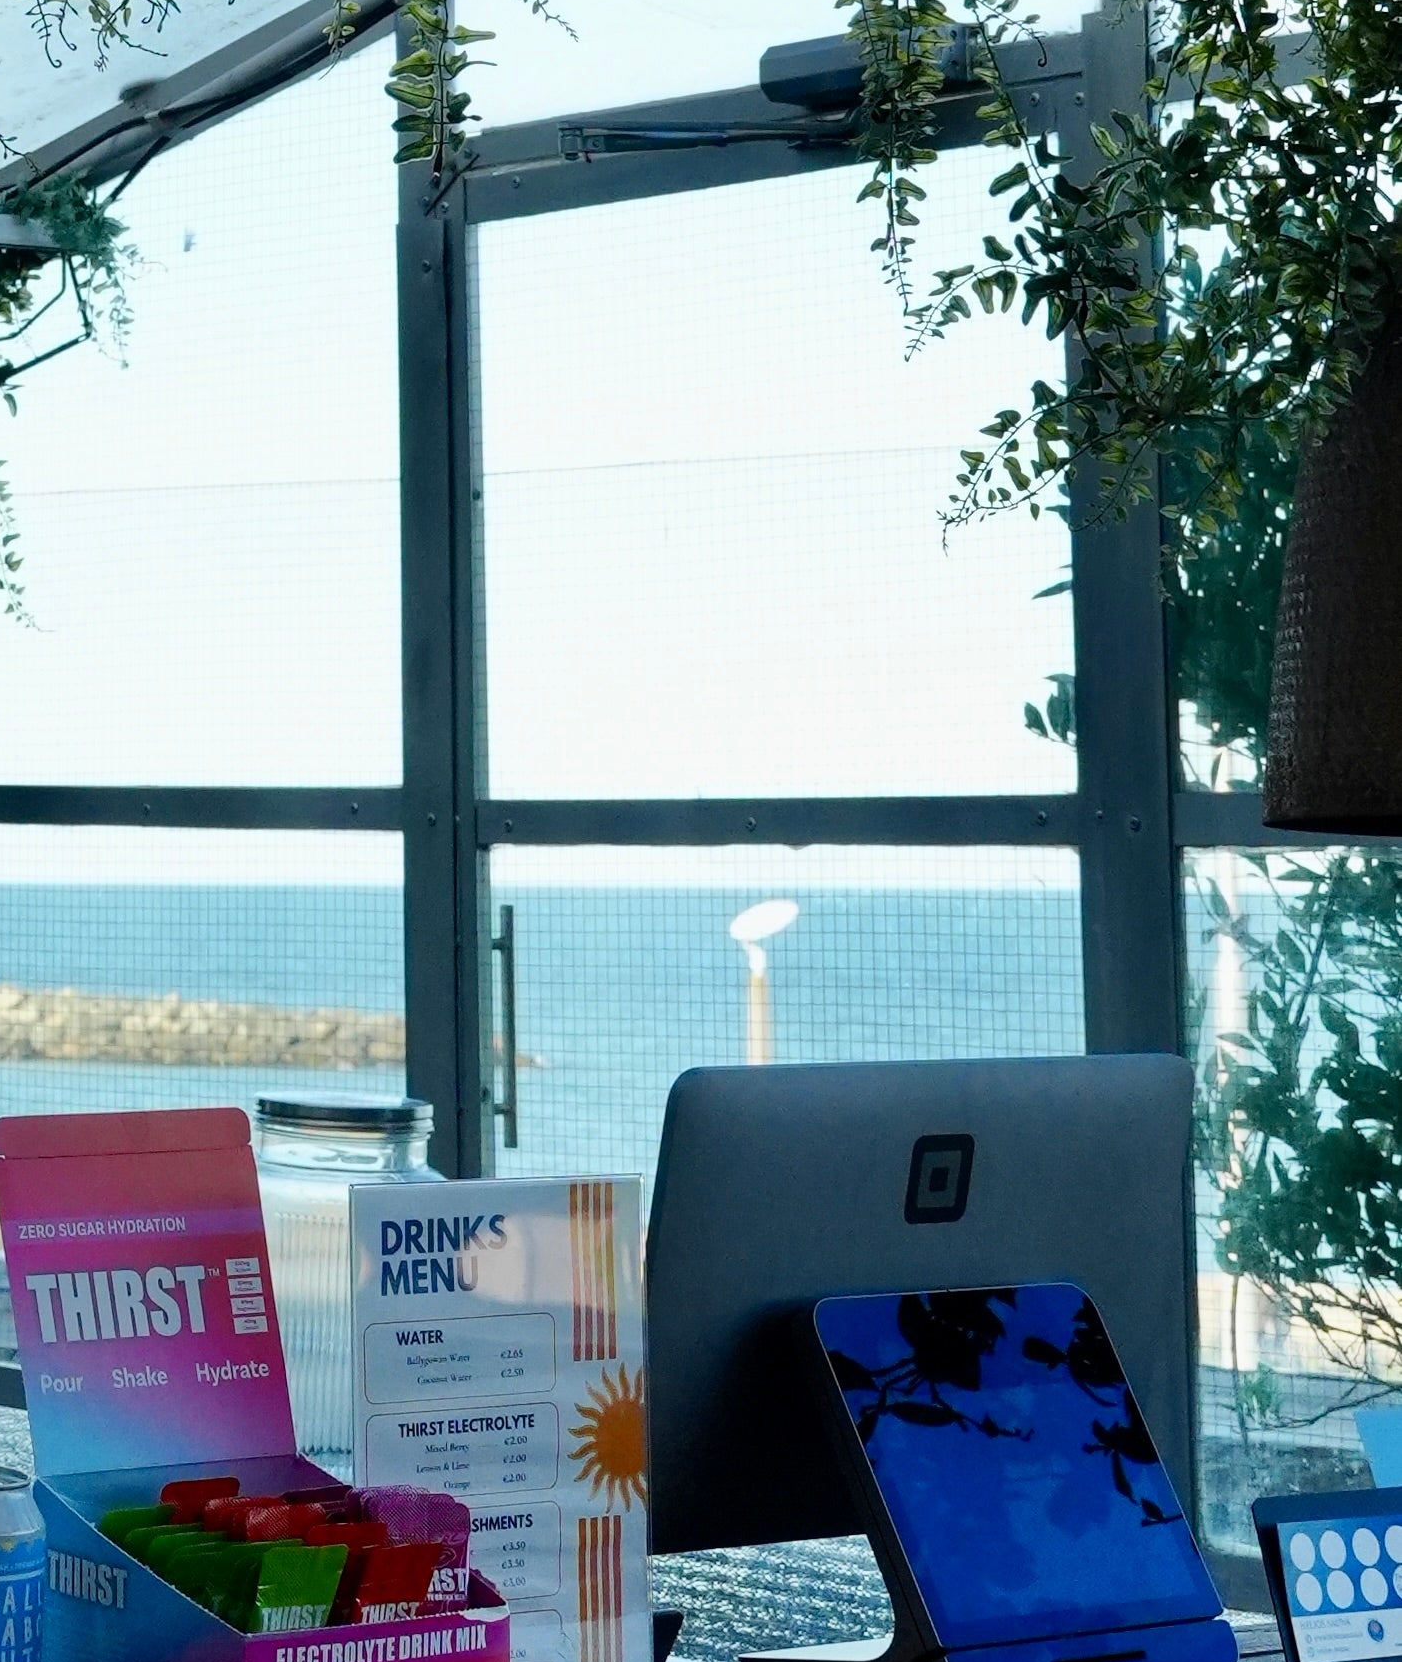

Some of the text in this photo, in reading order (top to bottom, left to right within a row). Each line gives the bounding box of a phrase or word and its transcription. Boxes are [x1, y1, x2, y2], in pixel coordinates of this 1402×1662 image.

[19, 1217, 186, 1239] ZERO SUGAR HYDRATION
[381, 1214, 507, 1256] DRINKS
[381, 1256, 478, 1296] MENU
[25, 1265, 206, 1343] THIRST
[396, 1330, 443, 1346] WATER
[41, 1359, 270, 1394] Pour Shake Hydrate
[398, 1414, 535, 1438] THIRST ELECTROLYTE
[48, 1548, 128, 1609] THIRST
[260, 1604, 327, 1632] THIRST
[361, 1602, 420, 1625] THIRST
[399, 1630, 453, 1660] DRINK
[455, 1625, 487, 1652] MIX
